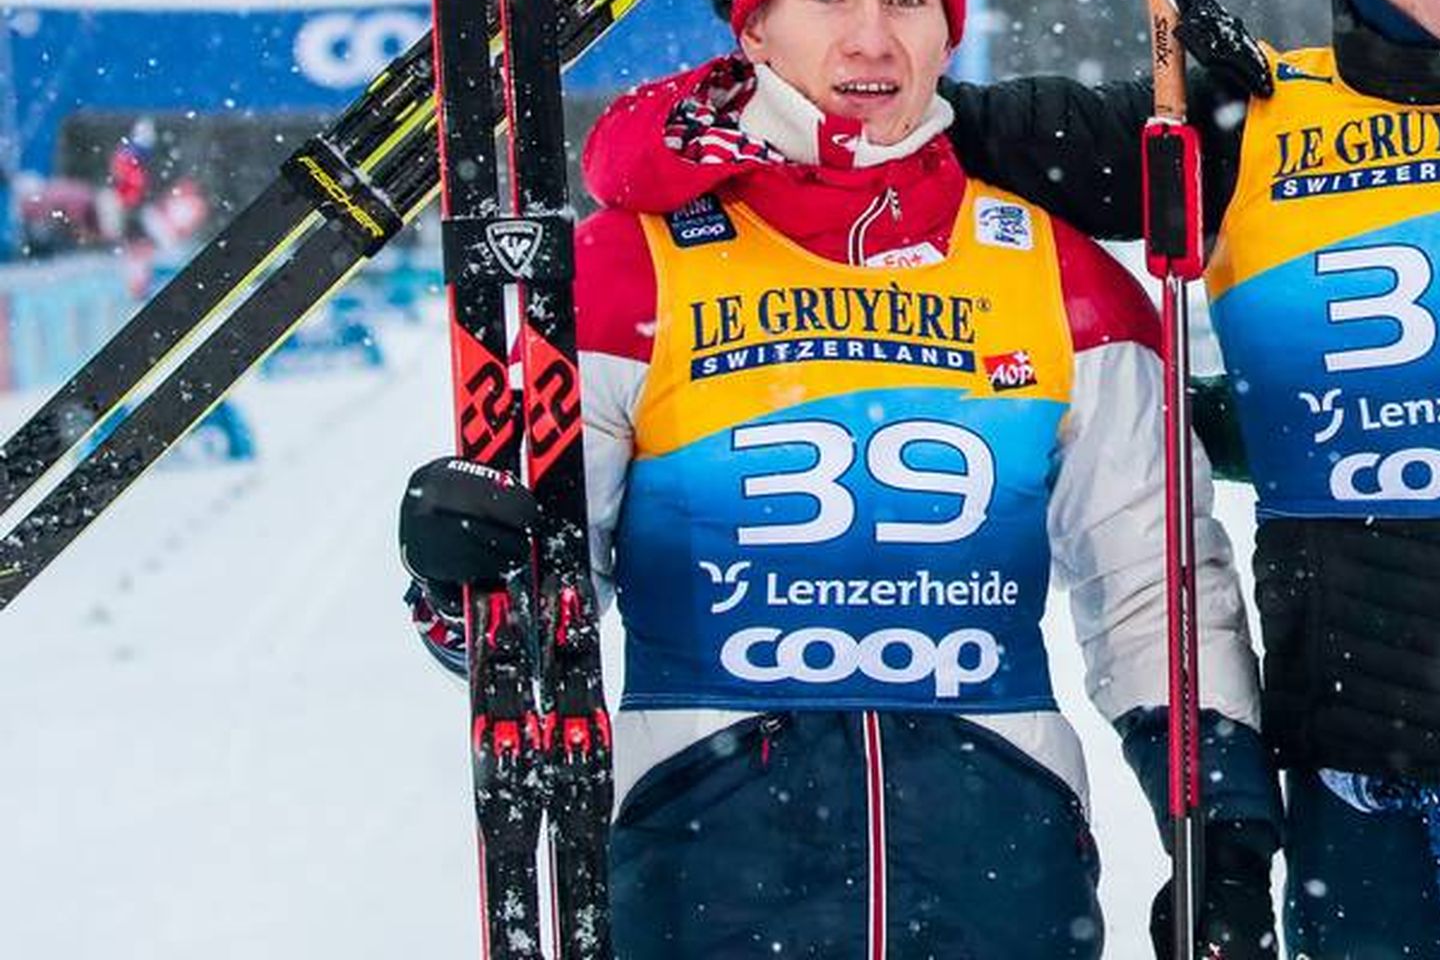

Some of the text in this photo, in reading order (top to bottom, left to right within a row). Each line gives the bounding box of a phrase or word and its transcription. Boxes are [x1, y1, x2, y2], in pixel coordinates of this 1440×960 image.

[1274, 126, 1324, 177] LE
[681, 224, 726, 240] coop
[690, 295, 744, 351] LE
[701, 341, 965, 375] SWITZERLAND
[731, 420, 996, 546] 39
[767, 570, 1019, 608] Lenzerheide
[720, 627, 1000, 697] coop
